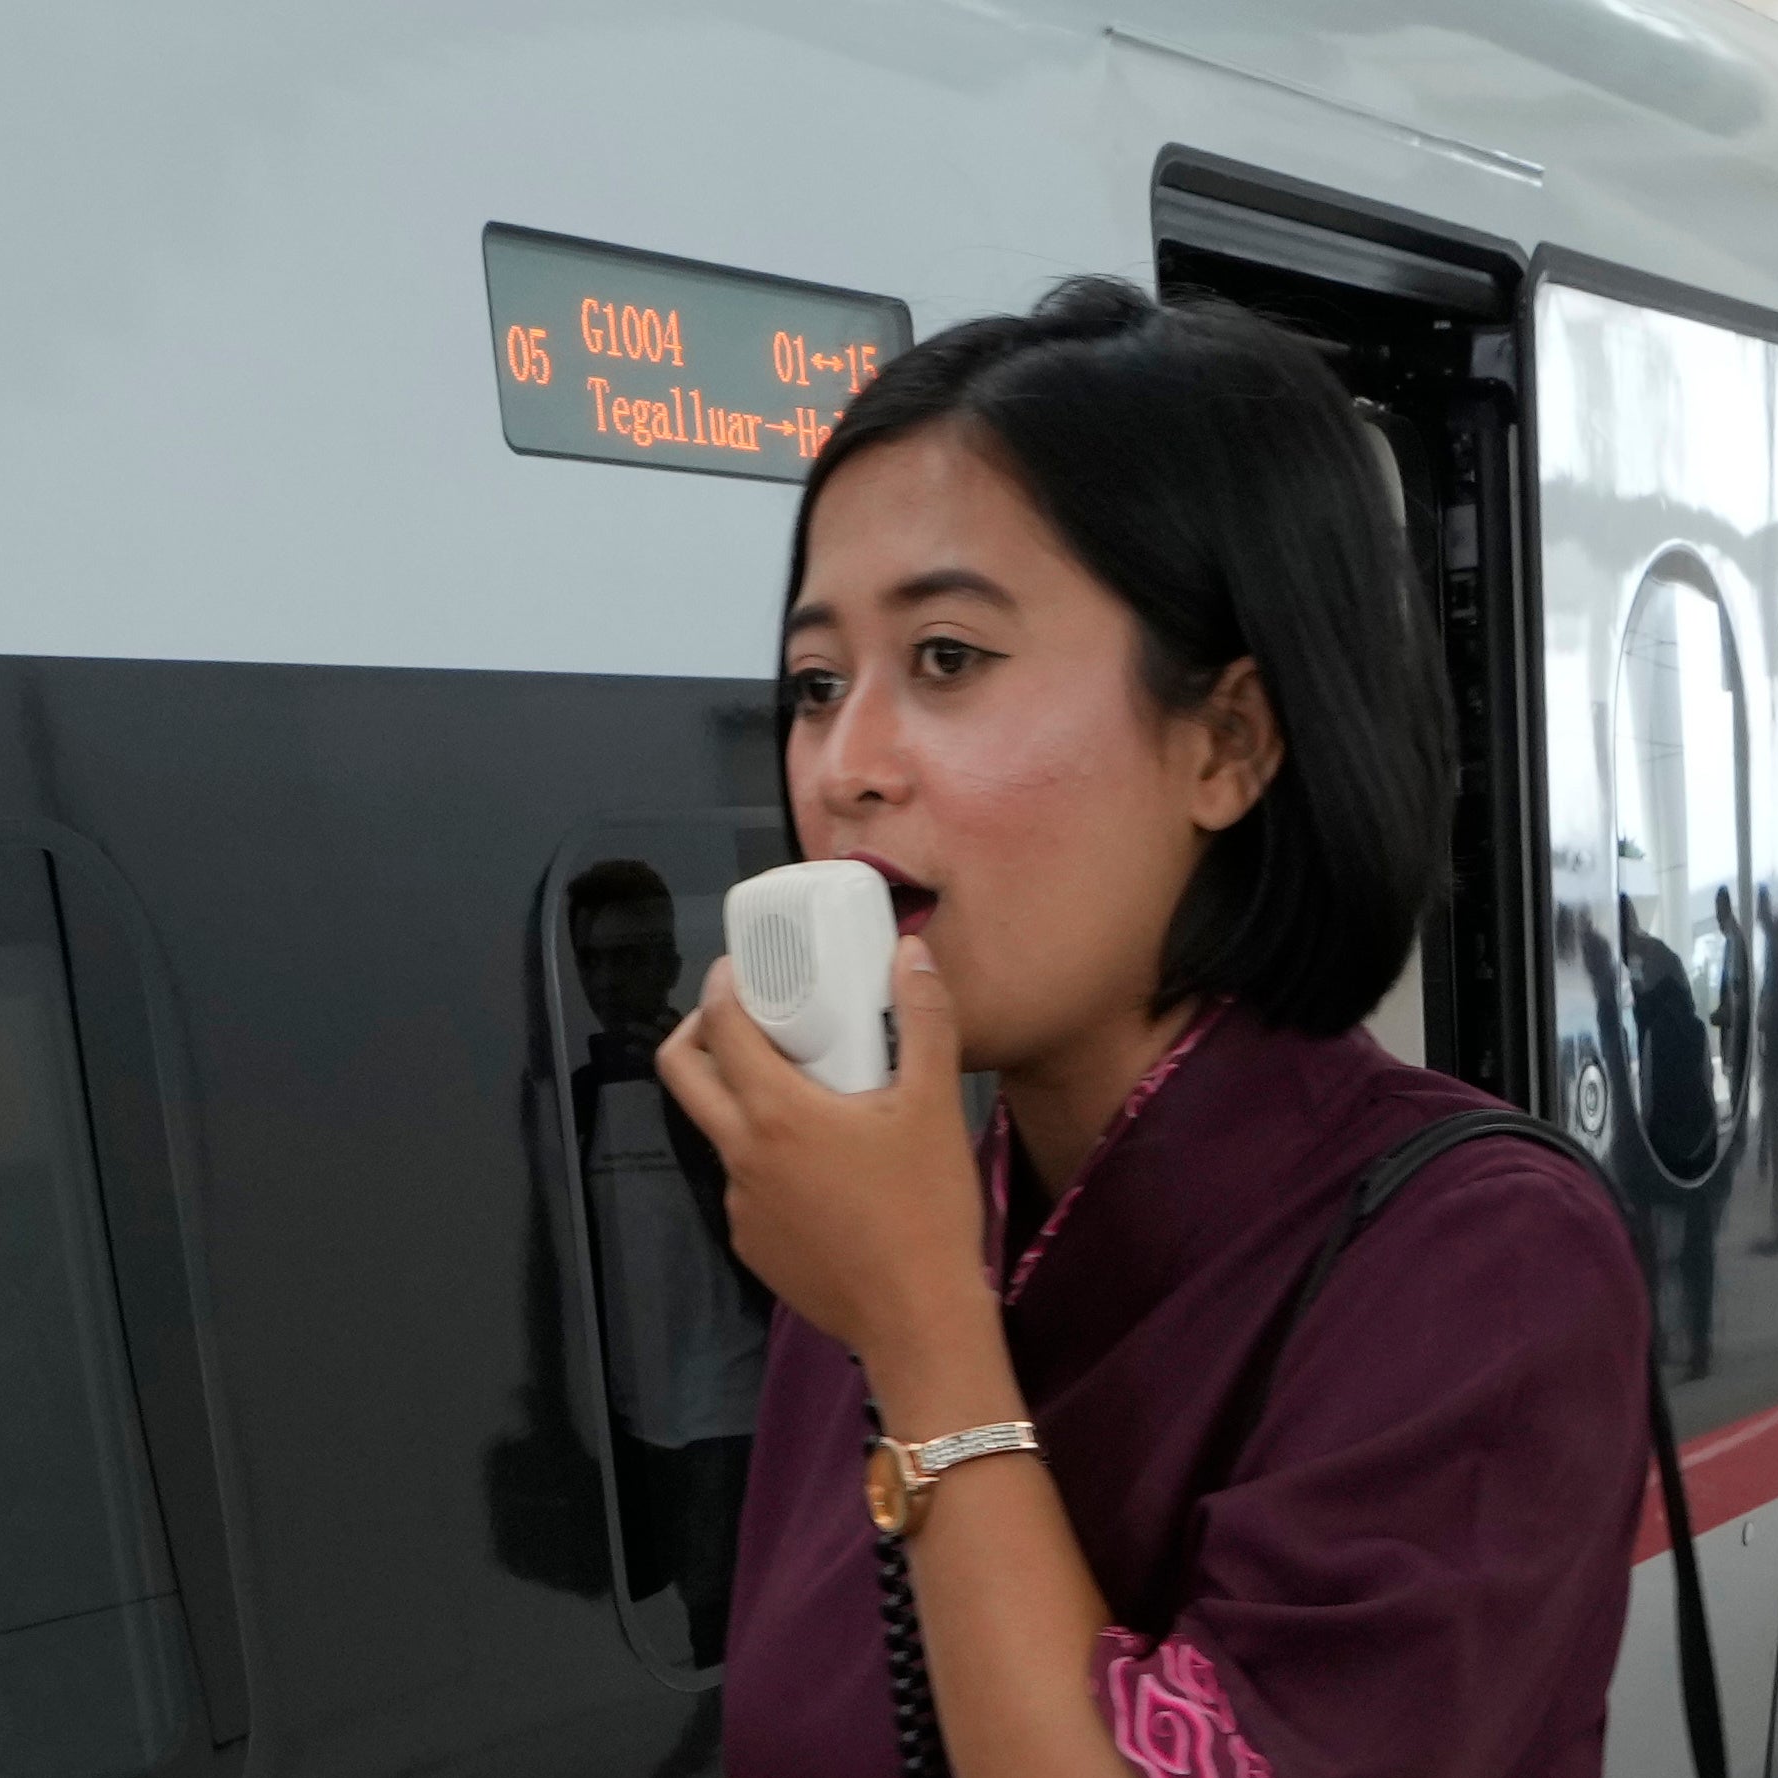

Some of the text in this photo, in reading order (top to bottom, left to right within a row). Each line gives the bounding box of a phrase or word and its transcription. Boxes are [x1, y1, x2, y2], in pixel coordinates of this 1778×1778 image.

[506, 324, 553, 386] 05
[580, 297, 686, 368] G1004
[772, 330, 811, 387] 01
[586, 375, 763, 453] Tegalluar
